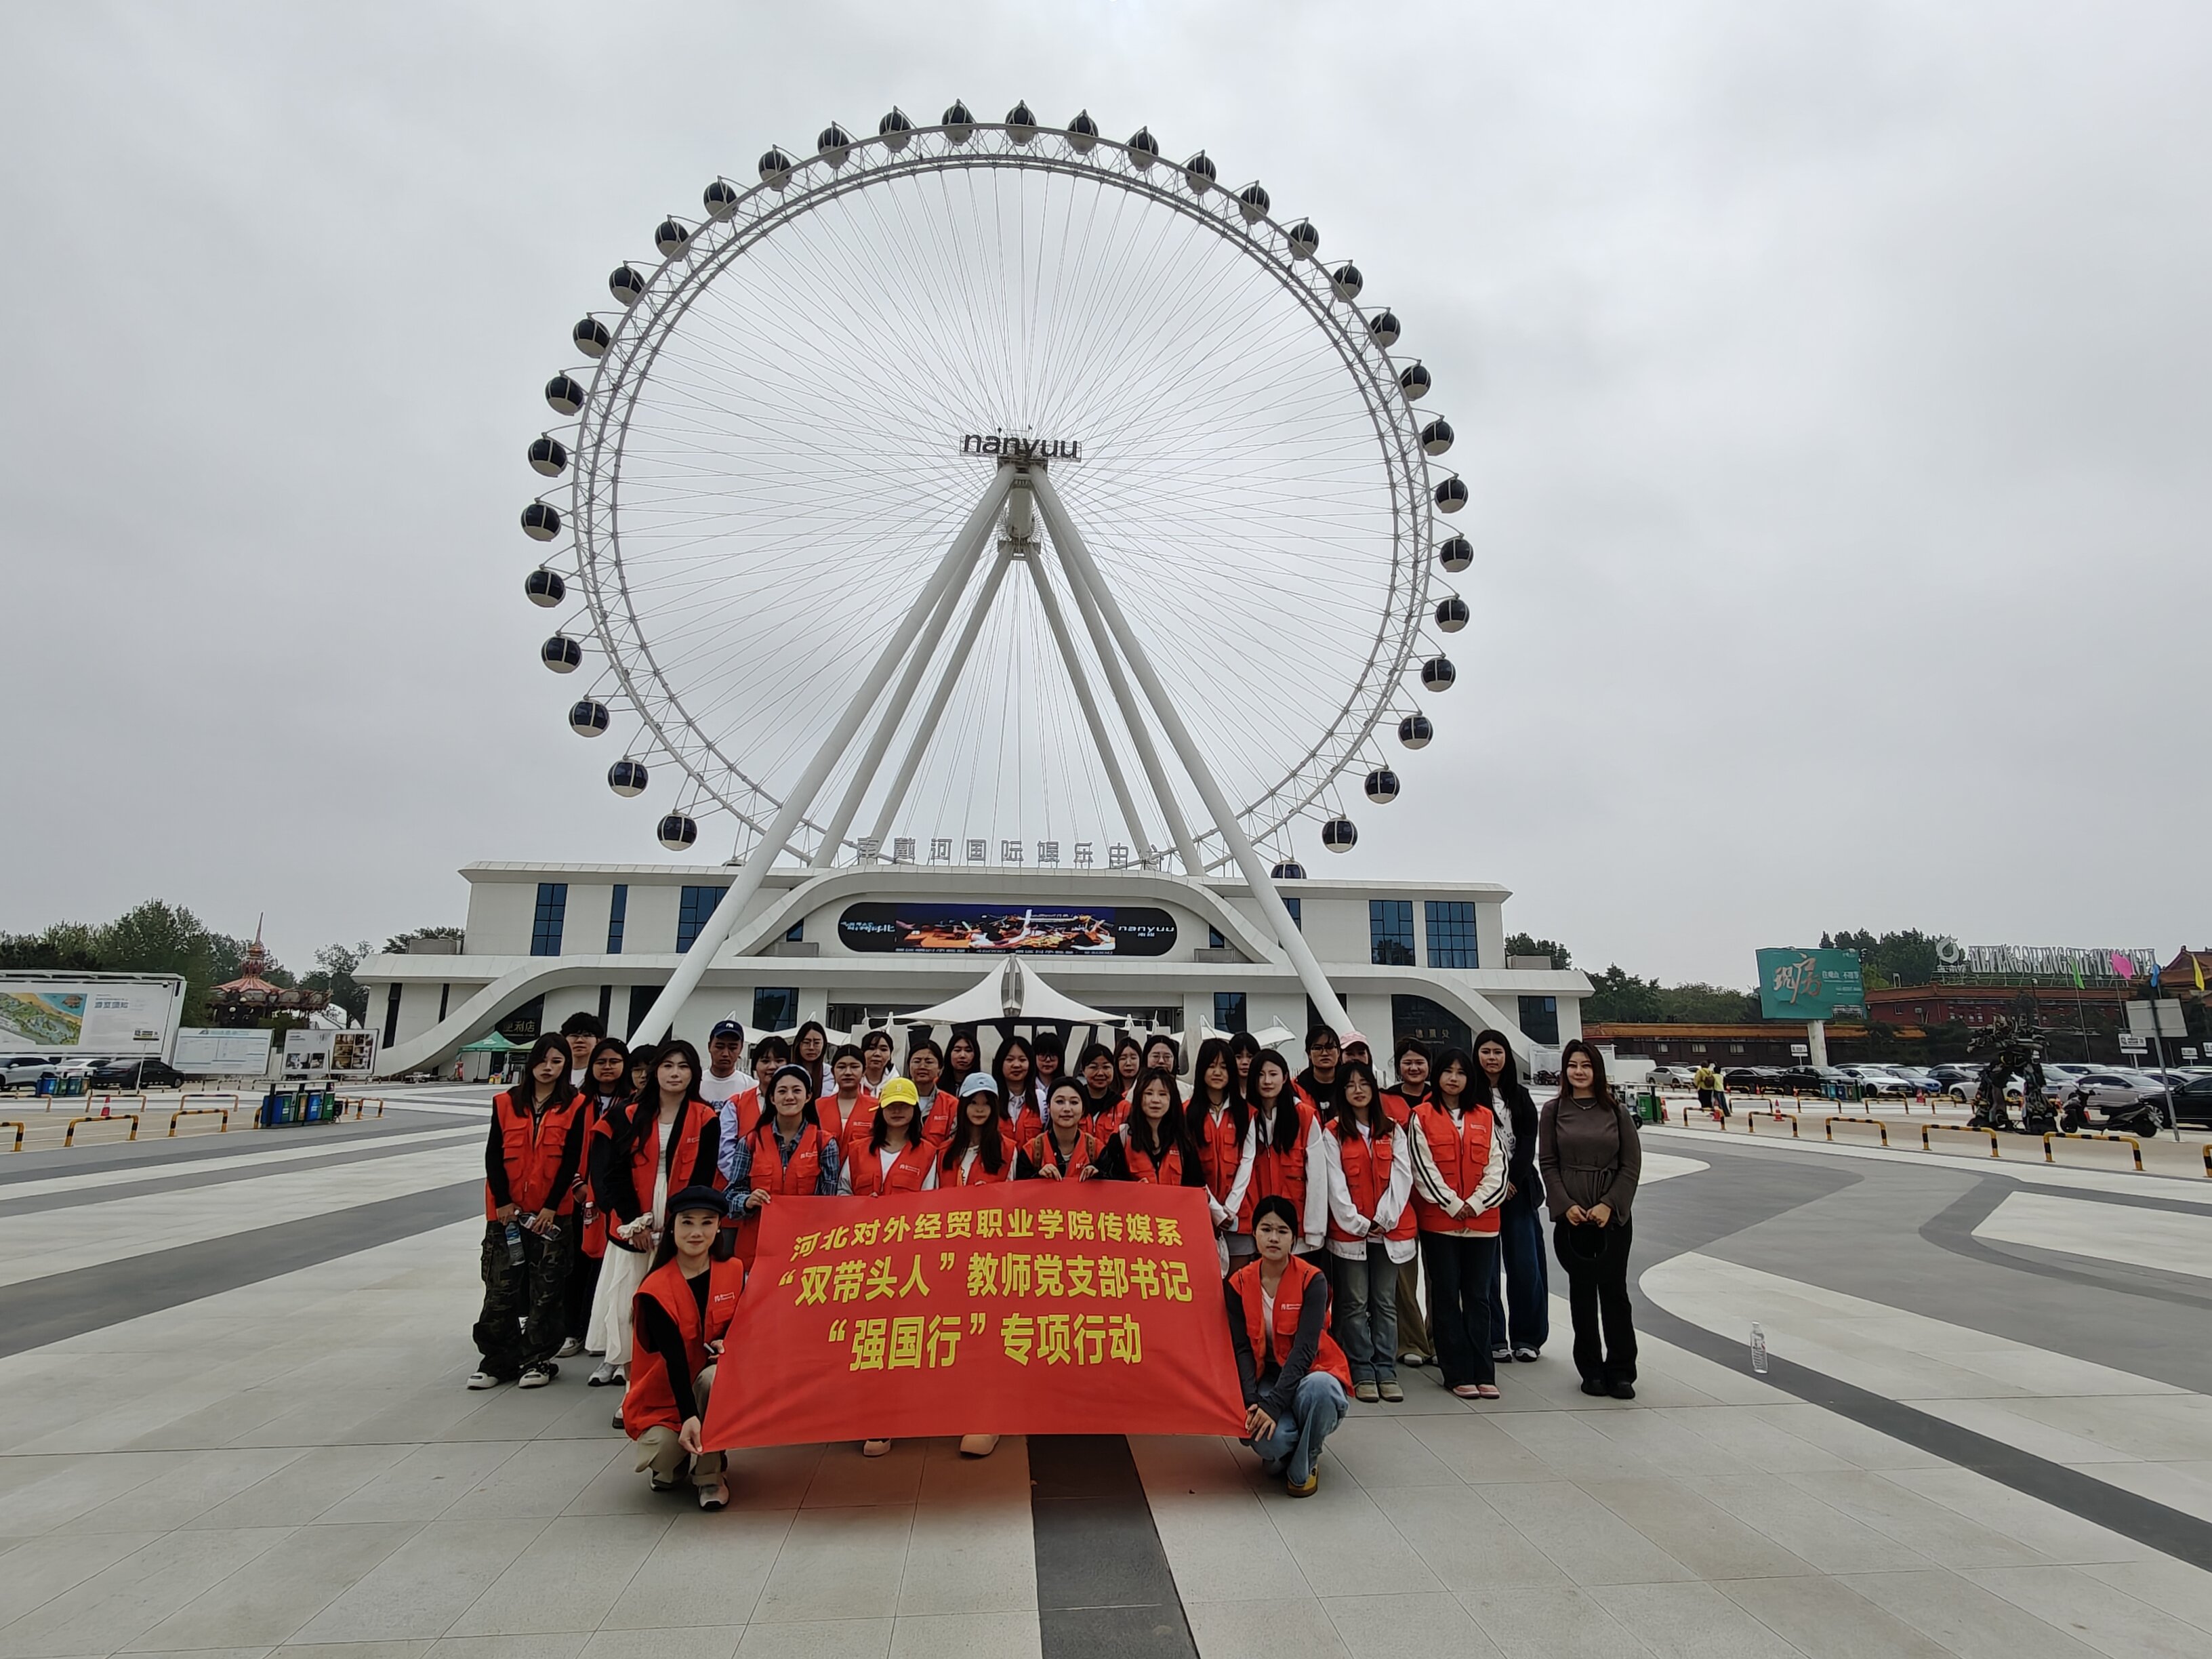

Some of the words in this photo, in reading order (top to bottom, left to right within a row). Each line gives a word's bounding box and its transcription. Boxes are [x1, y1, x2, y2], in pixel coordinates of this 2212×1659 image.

[963, 434, 1078, 459] nanyuu
[790, 1208, 1183, 1262] 河北对外经贸职业学院传媒系
